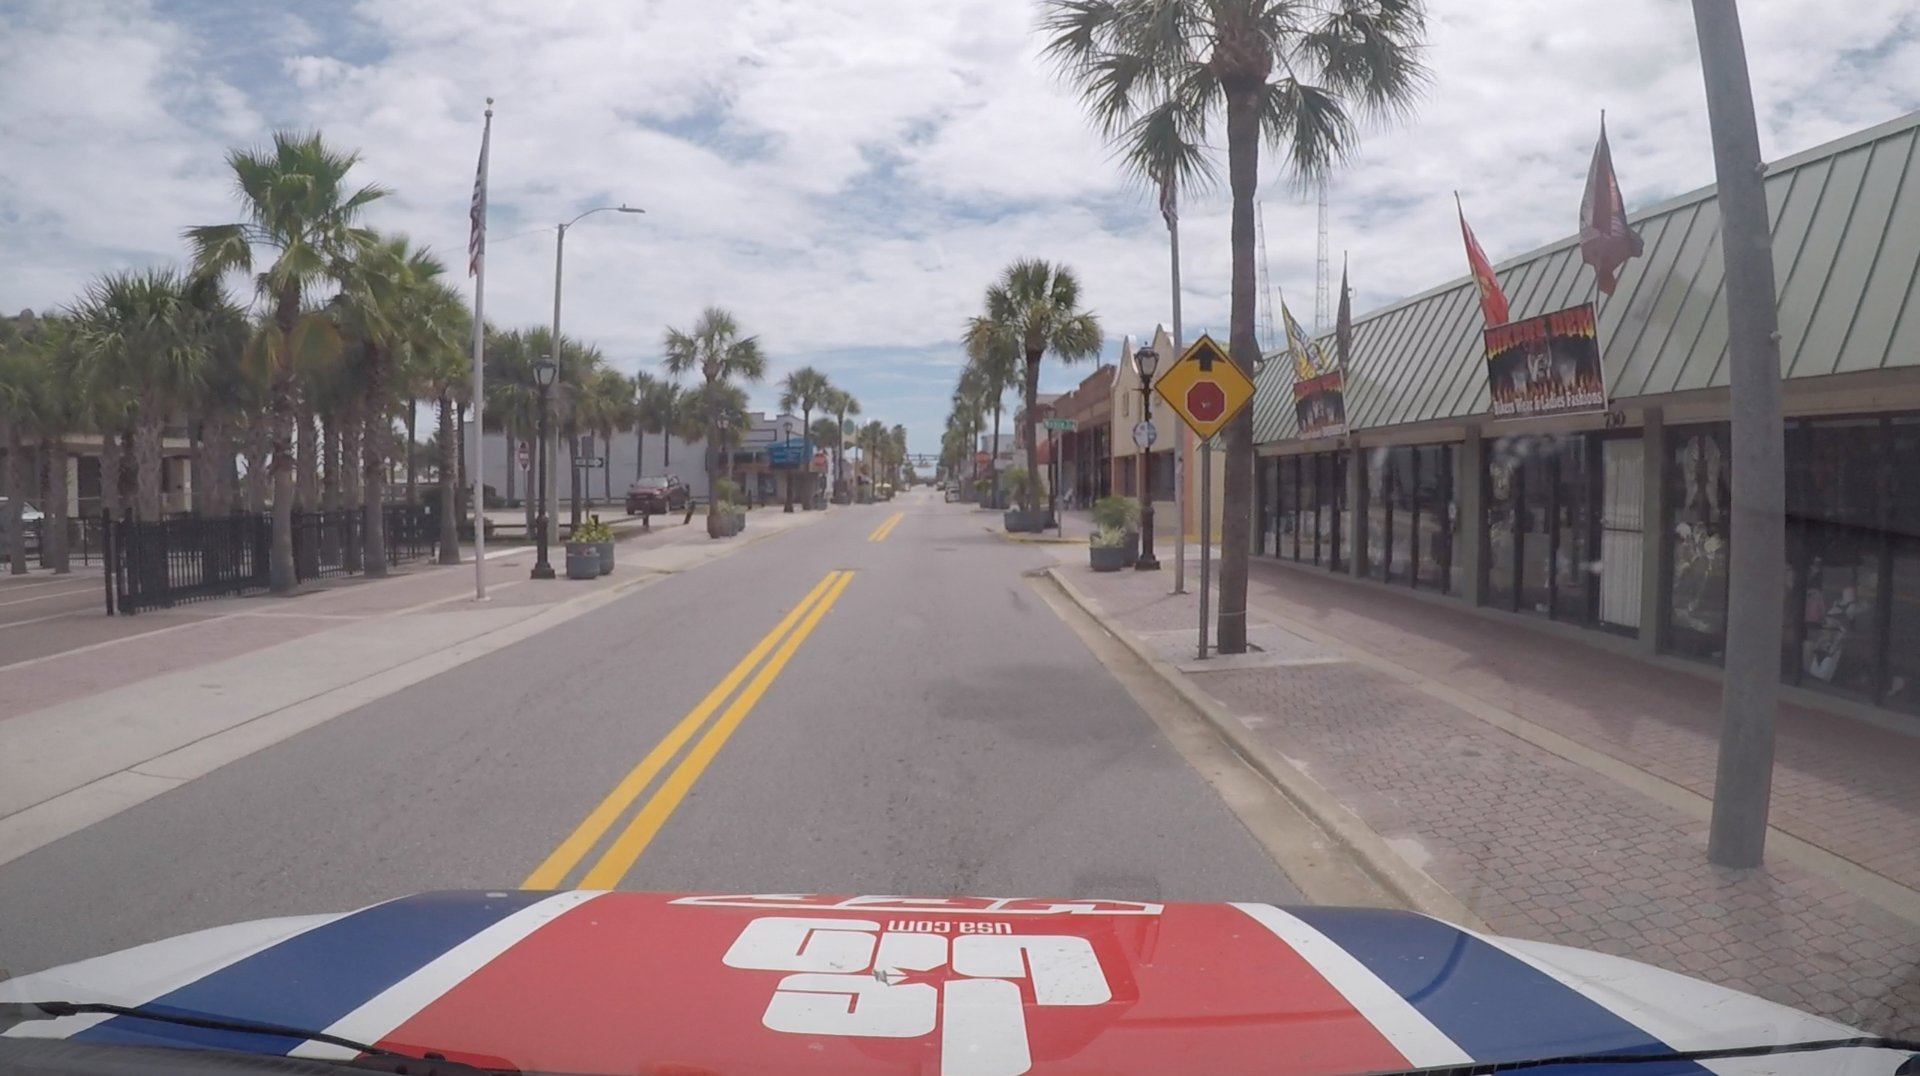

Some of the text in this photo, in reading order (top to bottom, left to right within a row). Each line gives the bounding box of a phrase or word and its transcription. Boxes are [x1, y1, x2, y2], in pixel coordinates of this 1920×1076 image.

[1541, 393, 1566, 410] Ladies
[1566, 388, 1603, 408] Fashions
[887, 920, 1013, 934] usa.com
